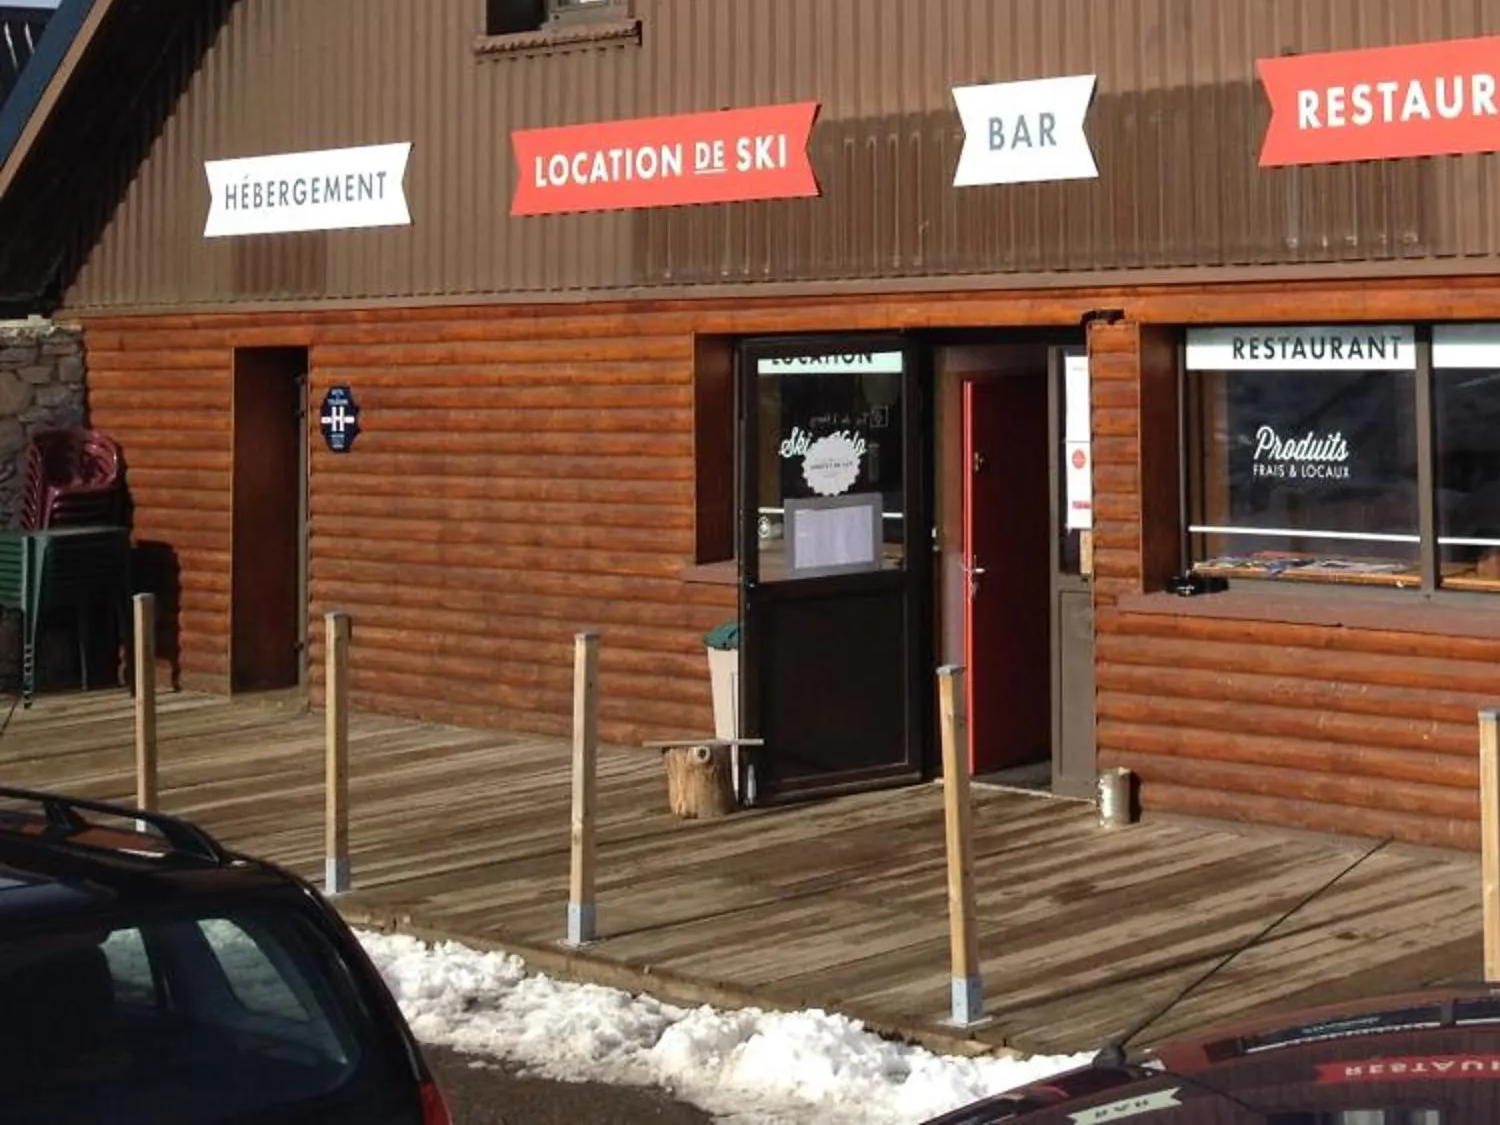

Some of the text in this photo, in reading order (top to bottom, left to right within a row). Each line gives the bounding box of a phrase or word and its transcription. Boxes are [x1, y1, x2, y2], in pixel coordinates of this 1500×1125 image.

[988, 112, 1057, 151] BAR
[535, 134, 787, 187] LOCATION DE SKI
[225, 171, 387, 210] HÉBERGEMENT
[1232, 335, 1404, 360] RESTAURANT
[1253, 425, 1350, 462] Produits
[1253, 464, 1349, 479] FRAIS & LOCAUX
